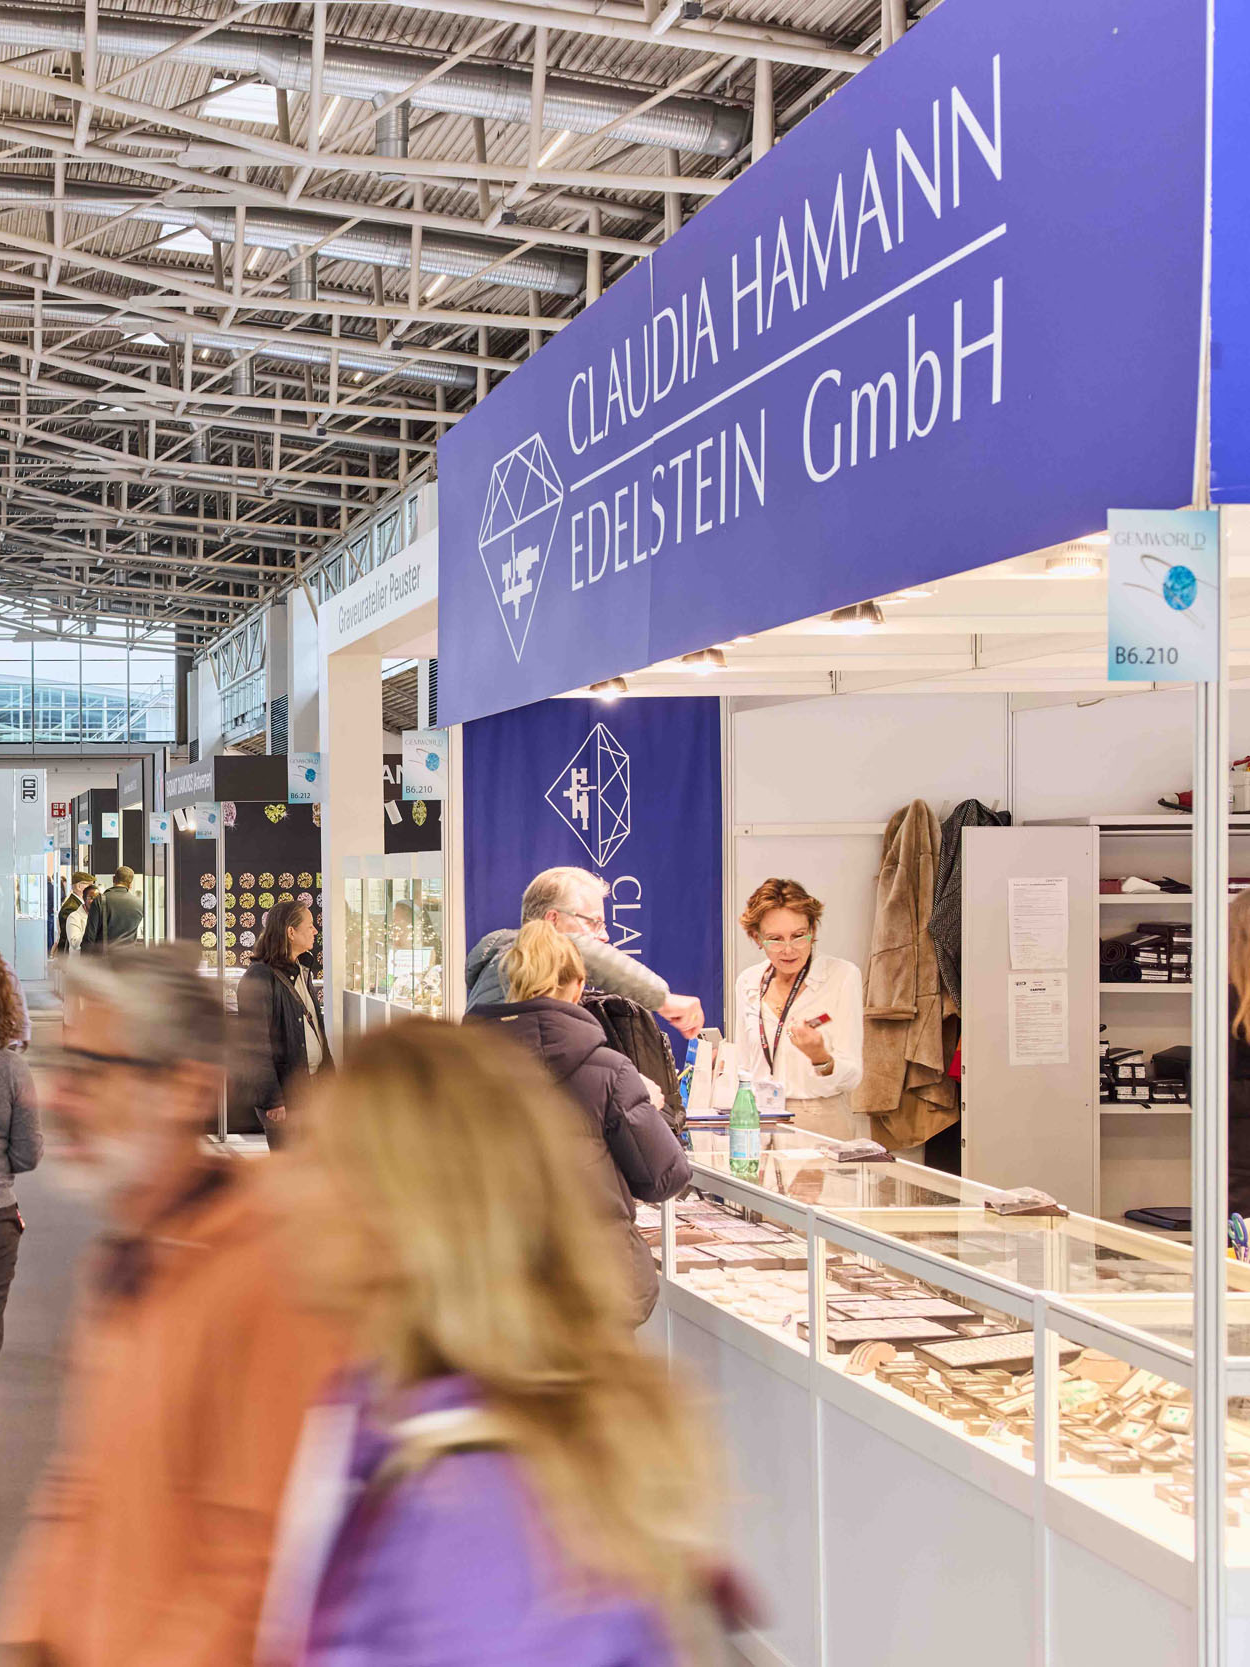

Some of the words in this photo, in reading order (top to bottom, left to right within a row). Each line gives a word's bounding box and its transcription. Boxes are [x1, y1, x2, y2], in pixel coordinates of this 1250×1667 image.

[568, 277, 719, 455] CLAUDIA
[731, 53, 1002, 351] HAMANN
[571, 408, 767, 592] EDELSTEIN
[803, 277, 1003, 483] GmbH
[1115, 531, 1206, 547] GEMWORLD
[338, 580, 388, 634] Graveuratelier
[389, 563, 421, 605] Peuster
[1115, 646, 1179, 665] B6.210
[405, 785, 433, 794] B6.210
